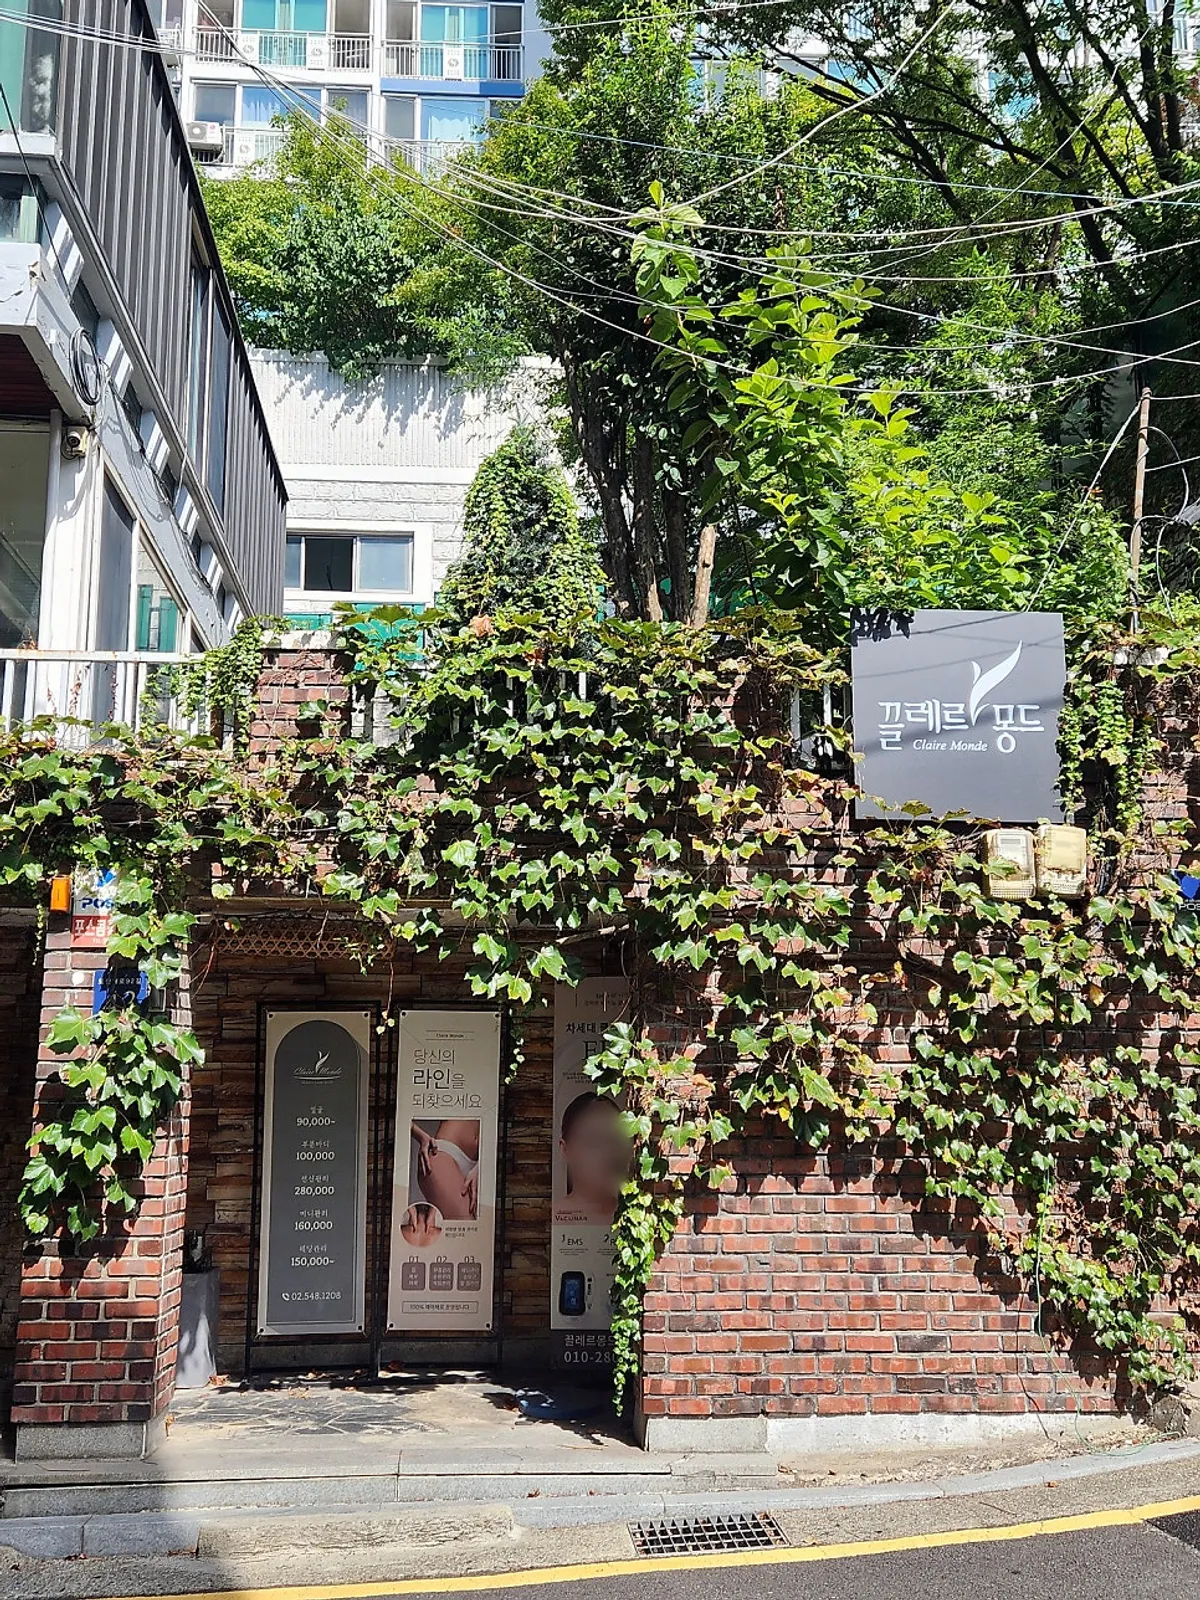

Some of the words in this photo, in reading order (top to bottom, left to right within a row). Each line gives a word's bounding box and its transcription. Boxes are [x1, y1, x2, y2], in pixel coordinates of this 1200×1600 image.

[878, 699, 969, 750] 끌레르
[993, 704, 1045, 753] 몽드
[913, 739, 947, 751] Claire
[949, 740, 988, 751] Monde
[74, 918, 111, 937] 포스공
[566, 1022, 597, 1034] 차세대
[413, 1048, 455, 1065] 당신의
[413, 1068, 466, 1090] 라인을
[412, 1093, 482, 1110] 되찾으세요
[296, 1151, 336, 1162] 100,000
[294, 1186, 335, 1198] 280,000
[294, 1221, 333, 1232] 160,000
[567, 1238, 584, 1246] EMS
